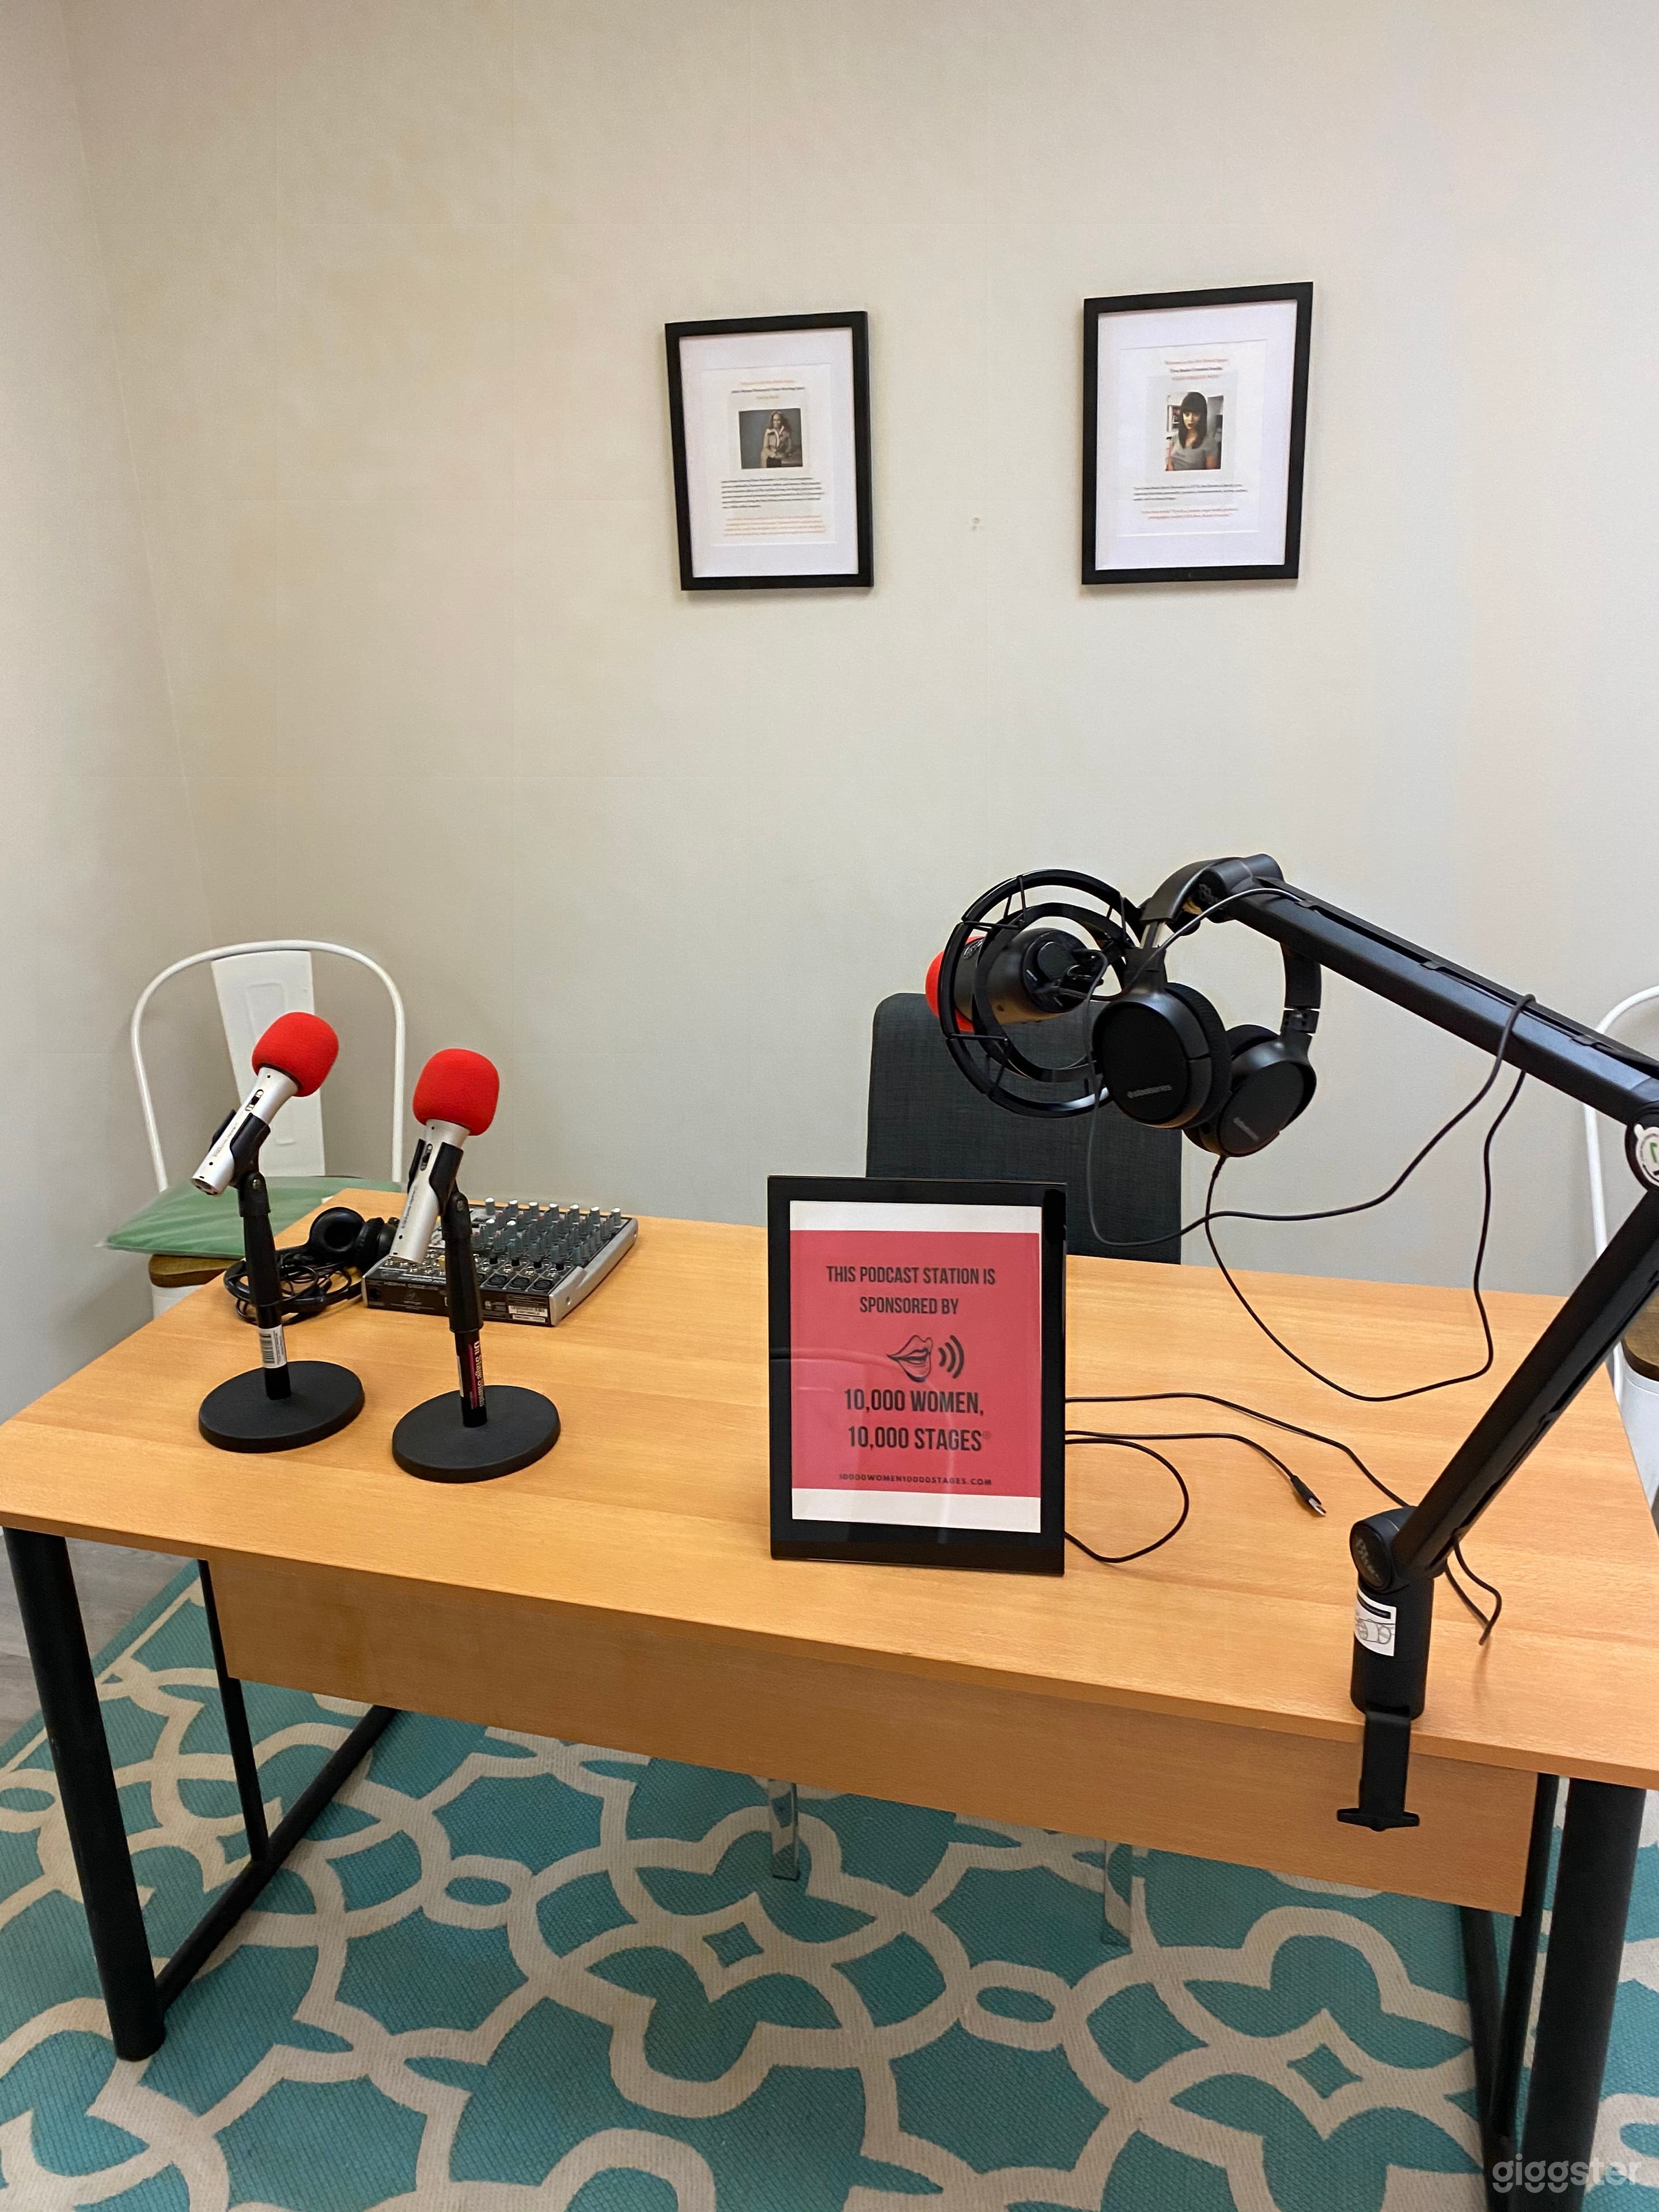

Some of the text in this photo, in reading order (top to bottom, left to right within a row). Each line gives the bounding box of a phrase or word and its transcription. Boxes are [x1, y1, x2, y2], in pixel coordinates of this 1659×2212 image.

[826, 1265, 995, 1286] THIS PODCAST STATION IS
[859, 1296, 959, 1315] SPONSORED BY
[844, 1388, 984, 1416] 10,000 WOMEN,
[848, 1425, 909, 1450] 10,000
